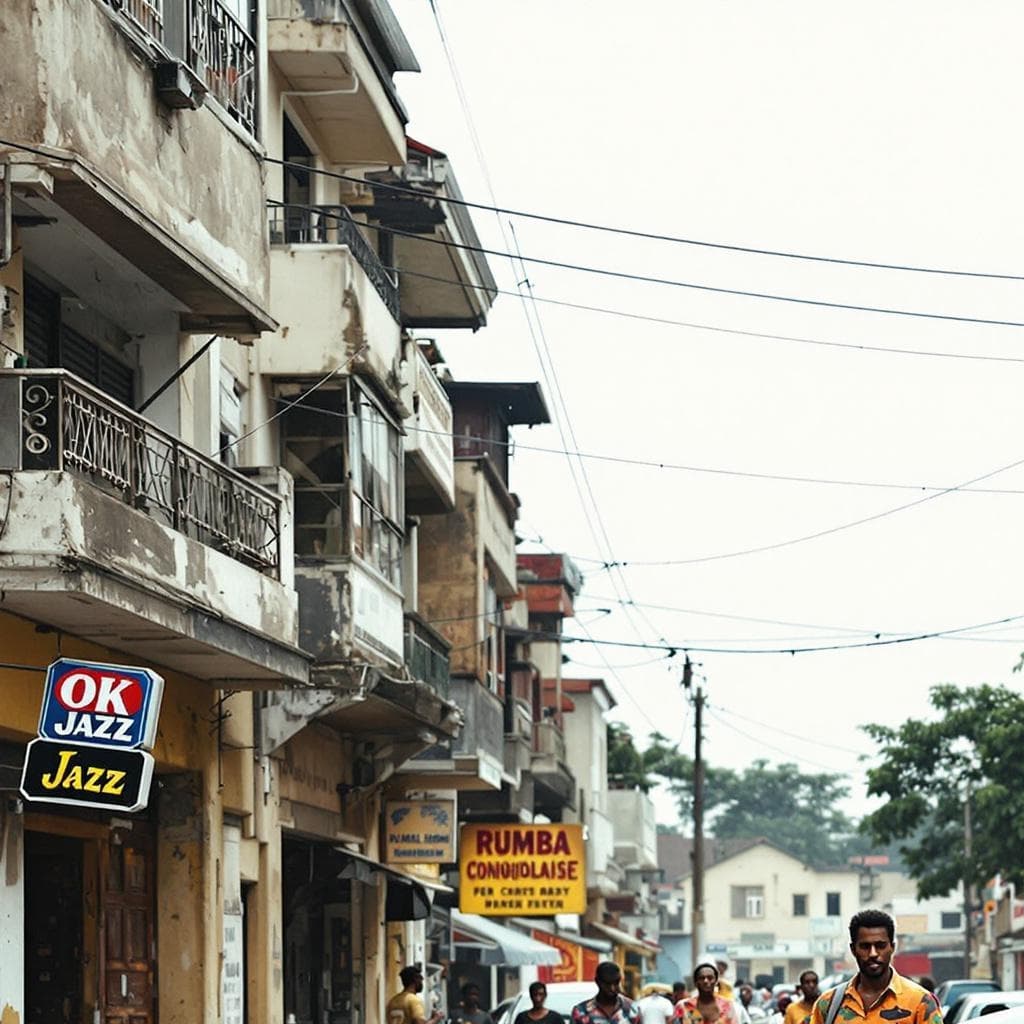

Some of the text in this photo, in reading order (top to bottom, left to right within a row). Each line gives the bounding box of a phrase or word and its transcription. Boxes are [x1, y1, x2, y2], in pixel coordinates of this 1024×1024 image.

[60, 673, 133, 716] OK
[54, 711, 134, 742] JAZZ
[476, 830, 571, 856] RUMBA
